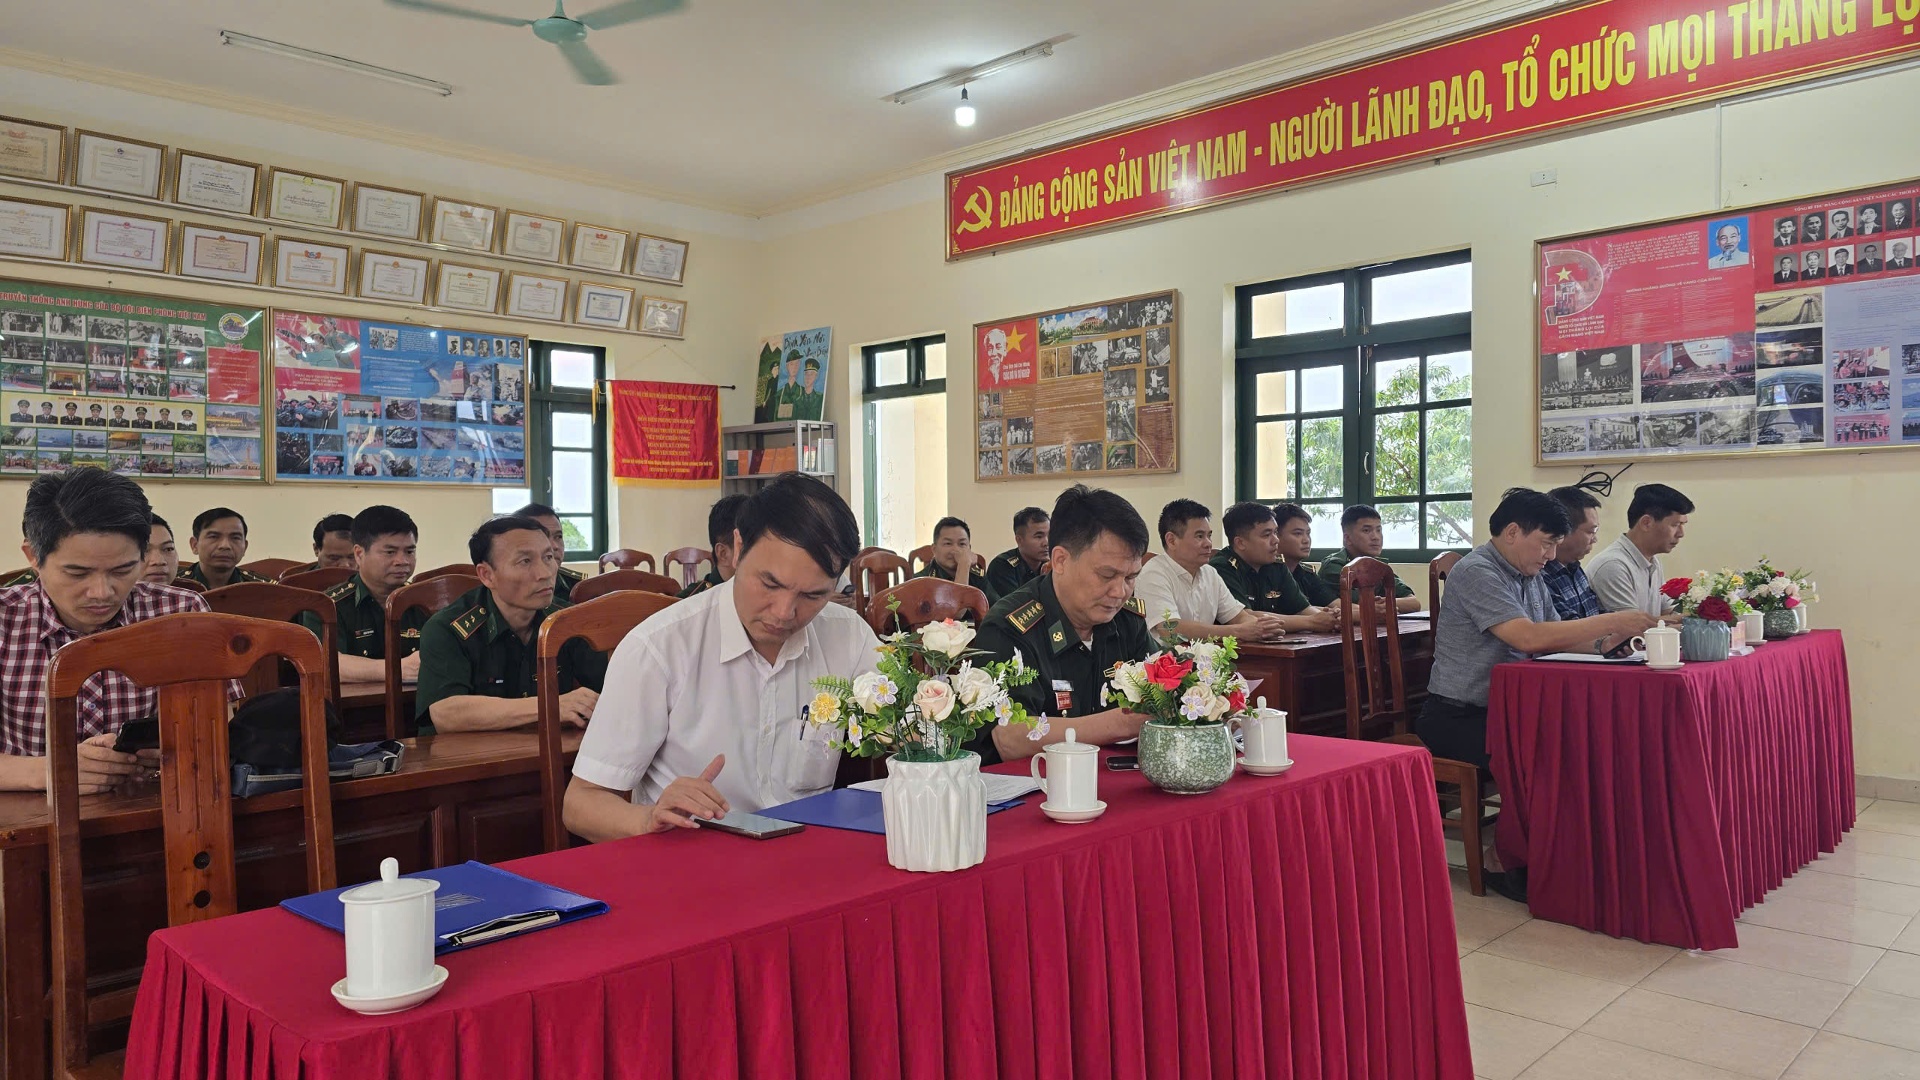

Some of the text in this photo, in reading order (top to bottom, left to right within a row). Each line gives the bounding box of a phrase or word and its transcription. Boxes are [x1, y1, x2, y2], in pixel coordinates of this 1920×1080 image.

[999, 175, 1045, 228] ĐẢNG
[1050, 166, 1098, 223] CỘNG
[1103, 147, 1143, 205] SẢN
[1148, 138, 1191, 199] VIỆT
[1196, 129, 1247, 183] NAM
[1269, 97, 1343, 166] NGƯỜI
[1351, 86, 1420, 148] LÃNH
[1427, 69, 1492, 136] ĐẠO,
[1502, 33, 1541, 112] TỔ
[1549, 25, 1636, 101] CHỨC
[1648, 9, 1716, 83] MỌI
